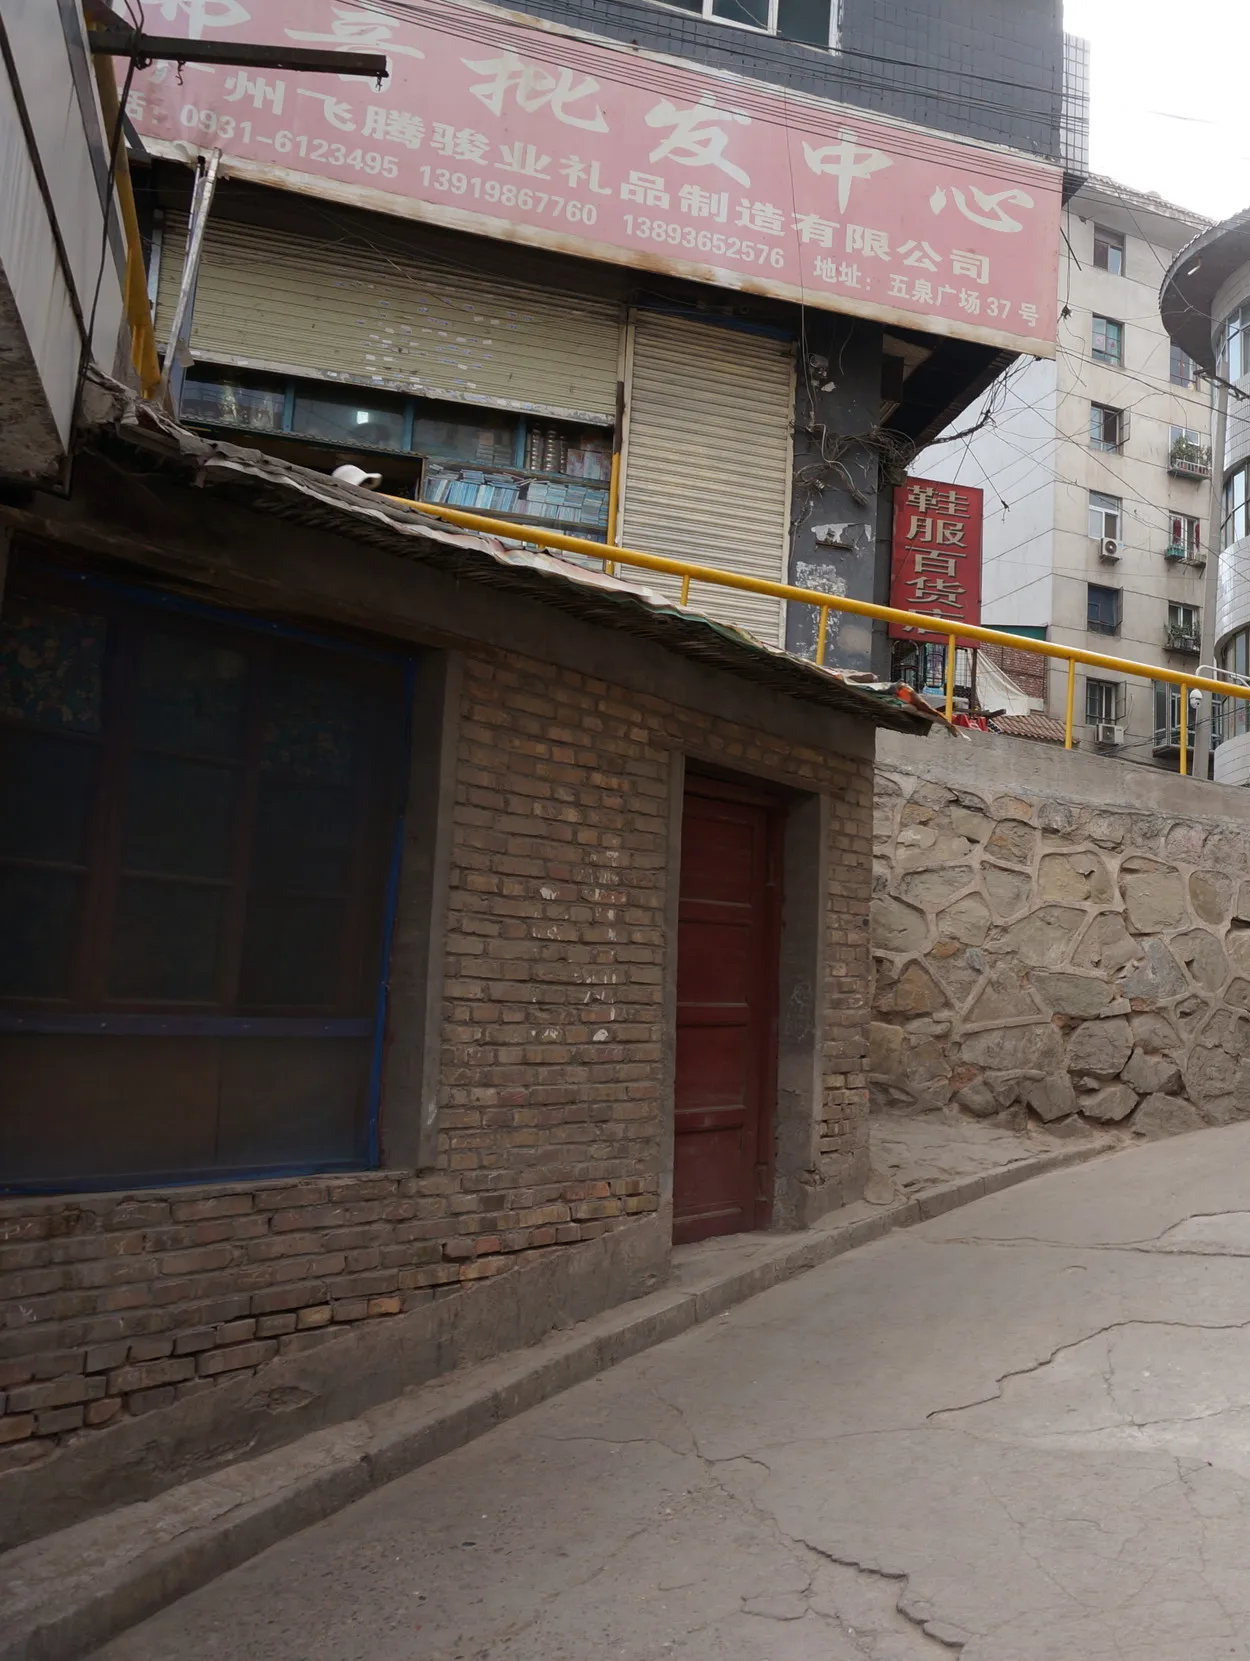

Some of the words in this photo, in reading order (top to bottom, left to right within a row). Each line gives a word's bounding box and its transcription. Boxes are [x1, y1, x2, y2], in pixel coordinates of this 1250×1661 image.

[186, 61, 991, 285] 州飞腾骏业礼品制造有限公司
[419, 164, 598, 226] 13919867760
[622, 213, 785, 269] 13893652576
